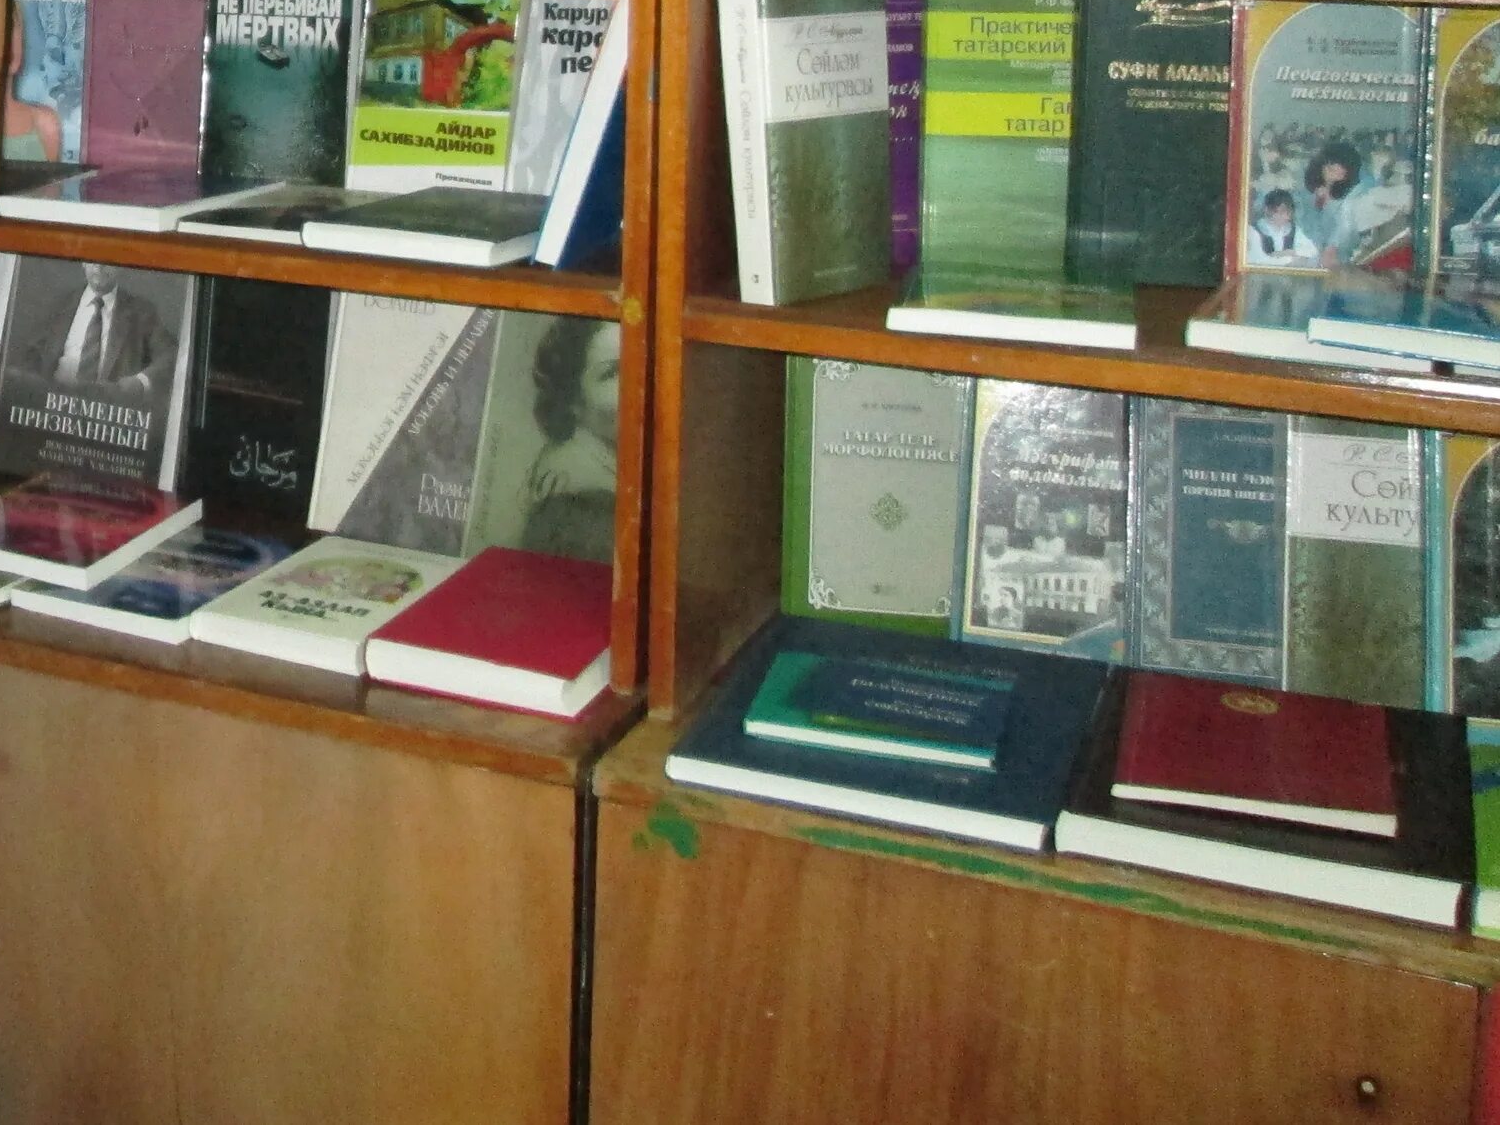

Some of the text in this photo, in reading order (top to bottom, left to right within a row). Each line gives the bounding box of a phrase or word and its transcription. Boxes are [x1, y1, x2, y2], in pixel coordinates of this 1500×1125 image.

[543, 2, 609, 26] Карур
[970, 16, 1073, 35] Практиче
[216, 14, 340, 51] МЕРТВЫХ
[954, 38, 1066, 55] татарский
[561, 55, 593, 75] пе
[796, 48, 861, 75] Сөйләм
[1107, 60, 1160, 82] СУФИ
[1275, 66, 1418, 86] Педагогически
[785, 77, 875, 113] культурасы
[1290, 85, 1409, 103] технологии
[436, 121, 497, 140] АЙДАР
[1004, 116, 1065, 134] татар
[360, 128, 495, 156] САХИБЗАДИНОВ
[45, 392, 152, 430] ВРЕМЕНЕМ
[9, 406, 149, 451] ПРИЗВАННЫЙ
[844, 430, 888, 443] ТАТАР
[1351, 469, 1414, 499] Сөй
[1327, 503, 1419, 537] культу
